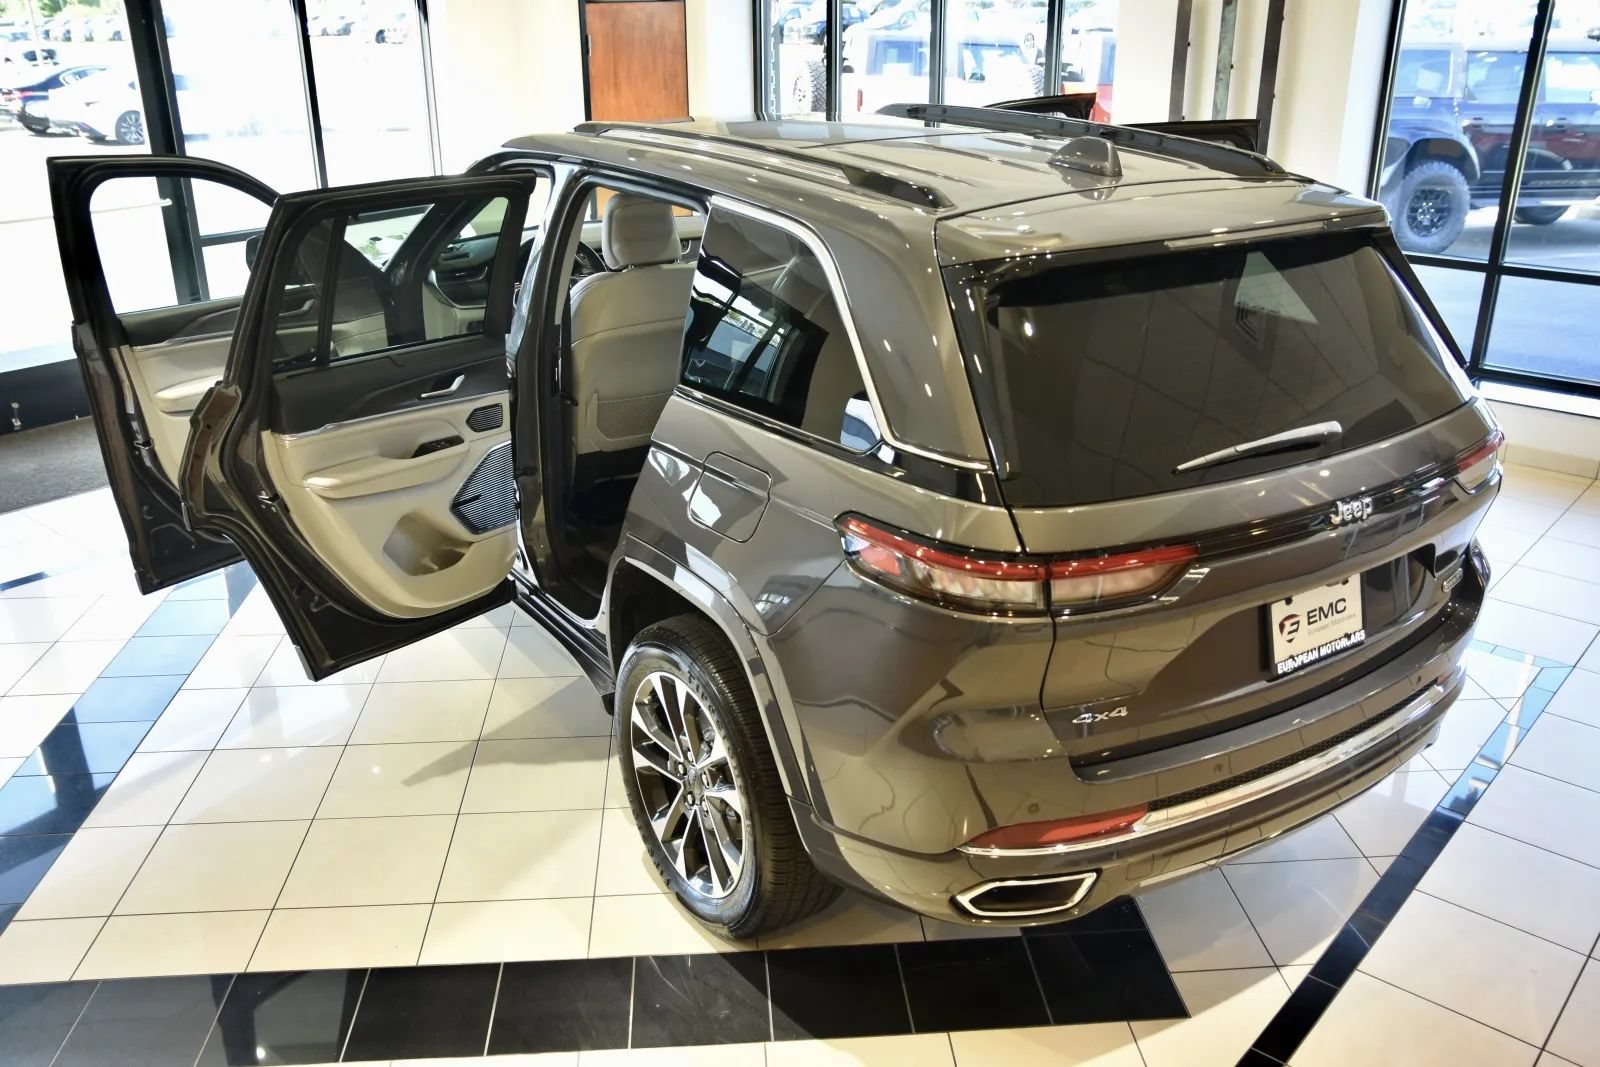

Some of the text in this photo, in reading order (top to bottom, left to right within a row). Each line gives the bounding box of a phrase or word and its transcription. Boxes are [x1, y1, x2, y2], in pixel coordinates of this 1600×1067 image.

[1329, 497, 1373, 525] Jeep
[1307, 598, 1347, 626] EMC
[1277, 630, 1366, 674] EUROPEAN MOTORCARS
[1072, 706, 1129, 724] 4x4
